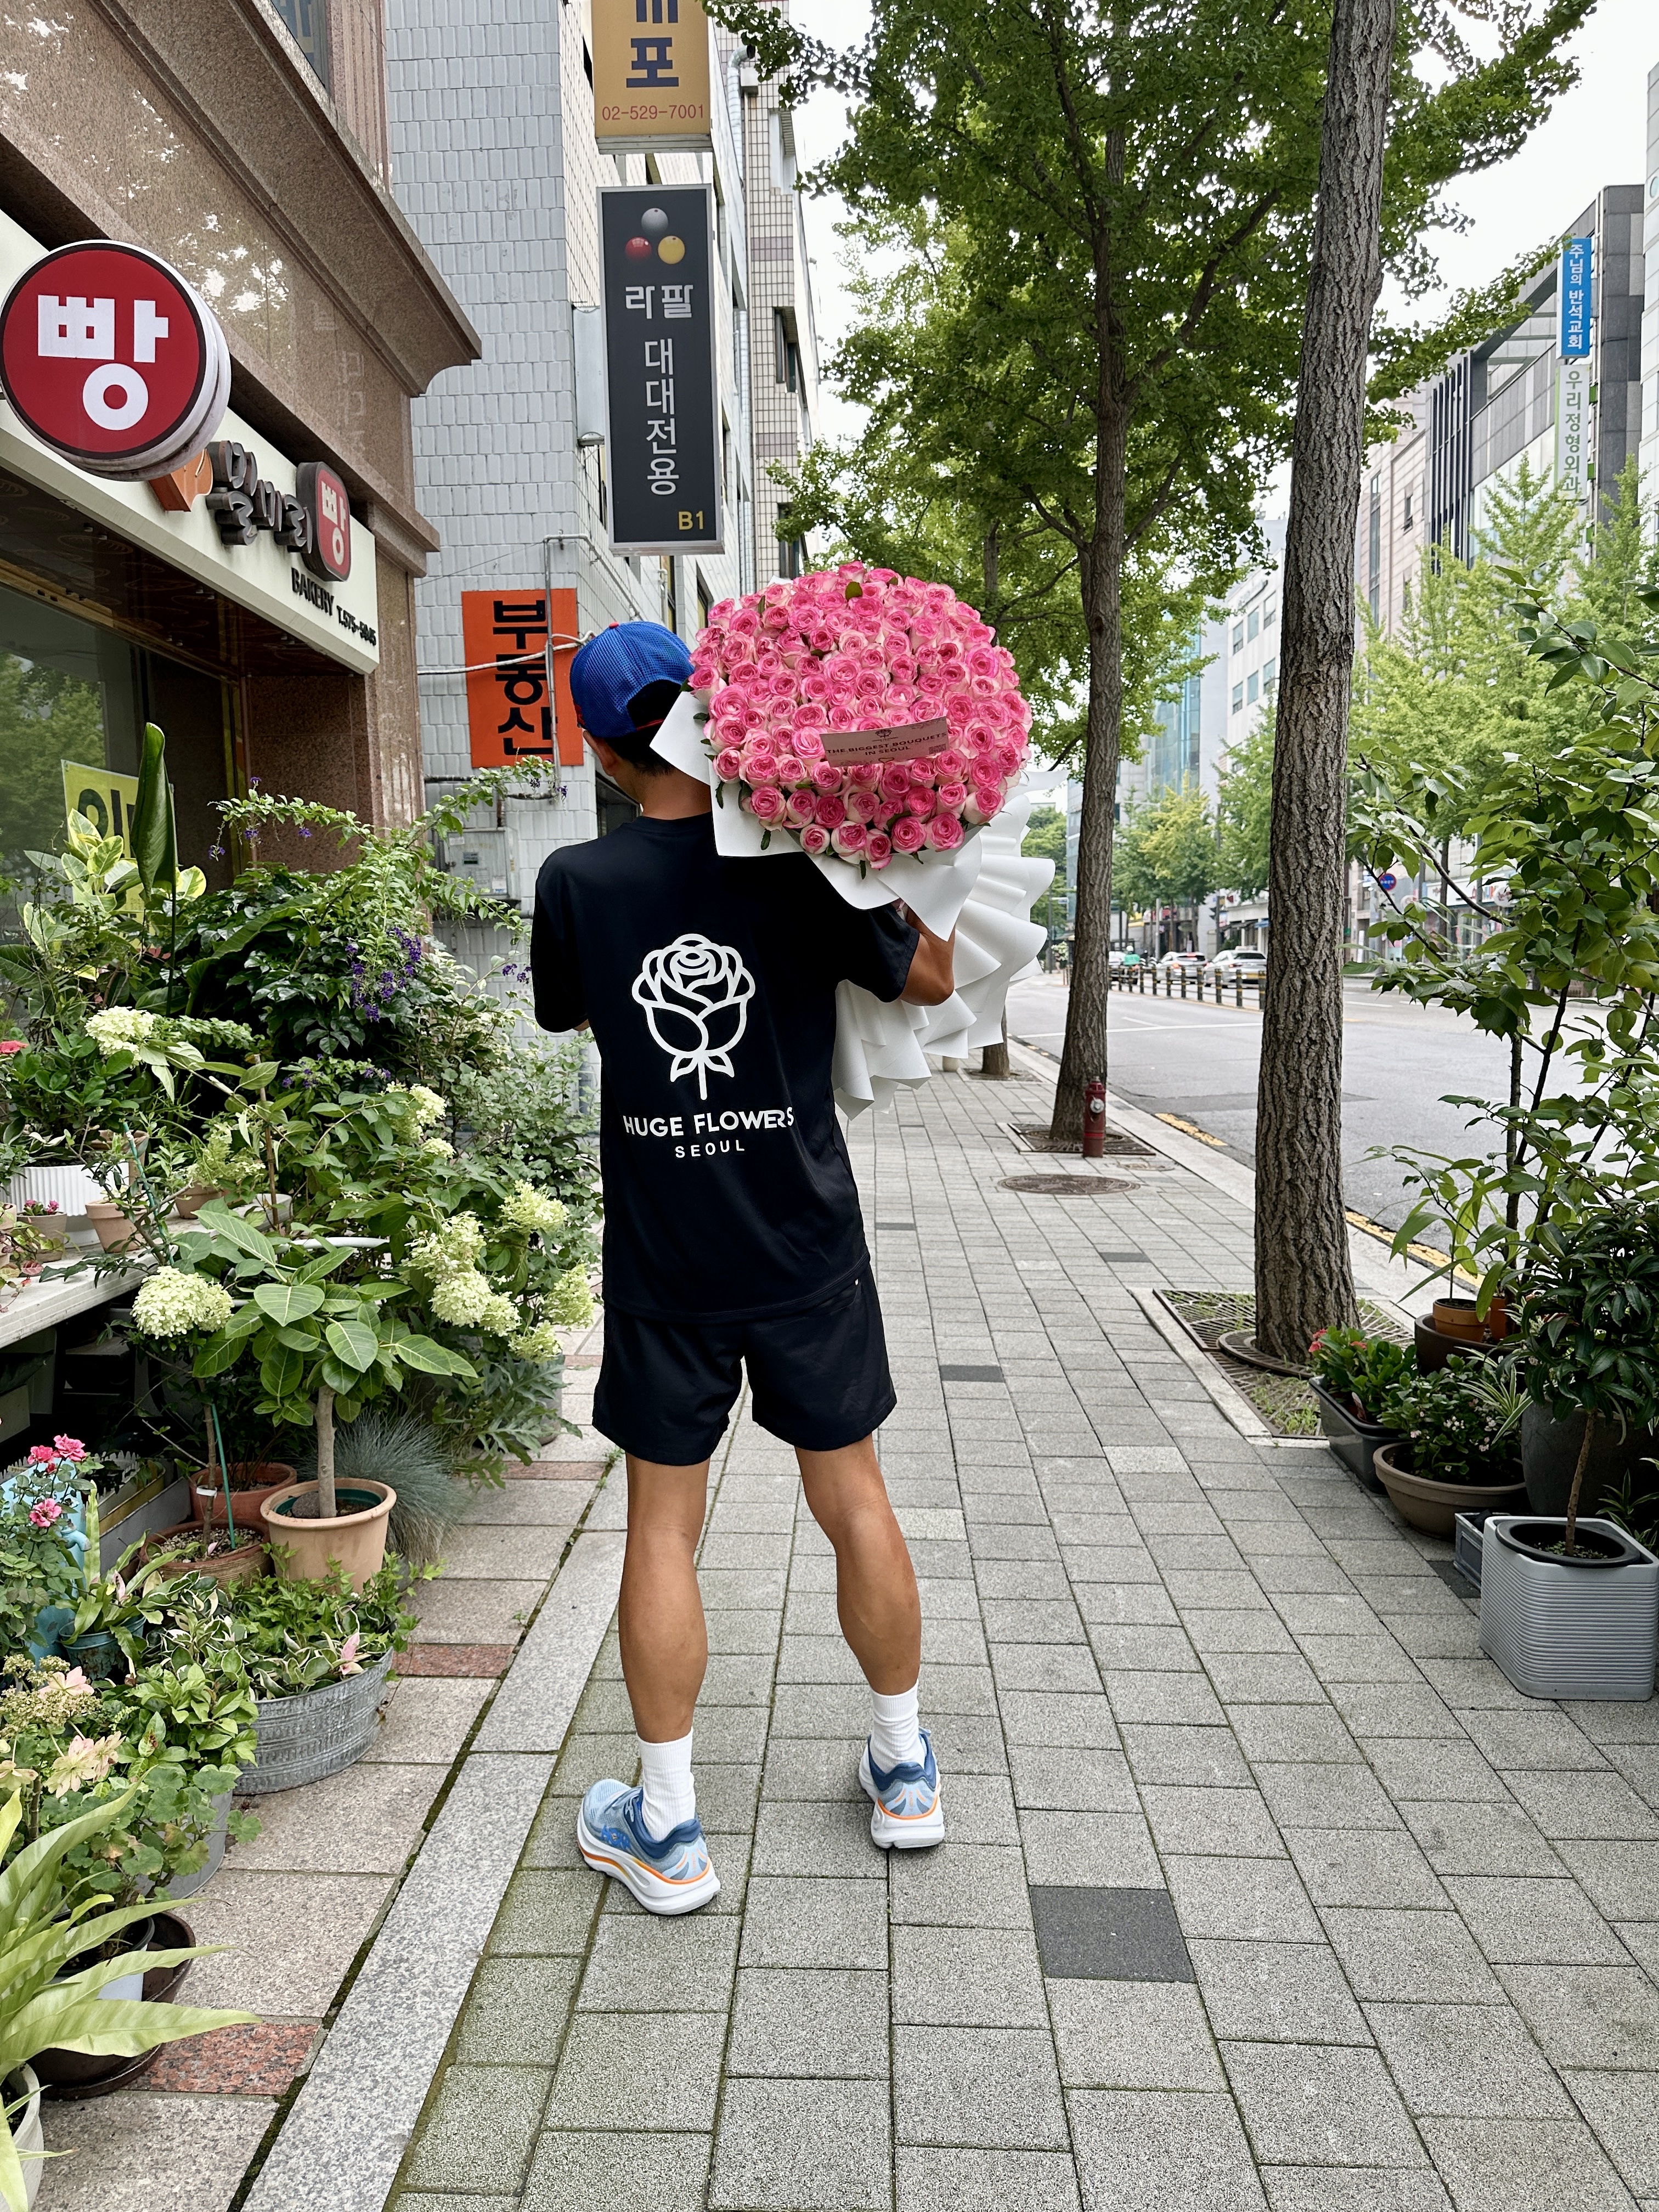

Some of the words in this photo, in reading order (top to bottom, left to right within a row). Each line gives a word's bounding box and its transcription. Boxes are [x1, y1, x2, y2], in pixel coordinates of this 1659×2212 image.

[602, 104, 704, 120] 02-529-7001
[1568, 244, 1584, 285] 주님의
[624, 284, 694, 319] 라팔
[1567, 290, 1584, 349] 반석교회
[38, 294, 169, 431] 빵
[644, 338, 679, 495] 대대전용
[1564, 370, 1582, 493] 우리정형외과
[678, 510, 704, 531] B1
[291, 567, 335, 616] BAKERY
[493, 600, 557, 756] 부동산
[848, 743, 889, 752] BIGGEST
[892, 732, 947, 747] BOUQUETS
[622, 1115, 684, 1137] HUGE
[693, 1107, 794, 1134] FLOWERS
[675, 1139, 745, 1158] SEOUL
